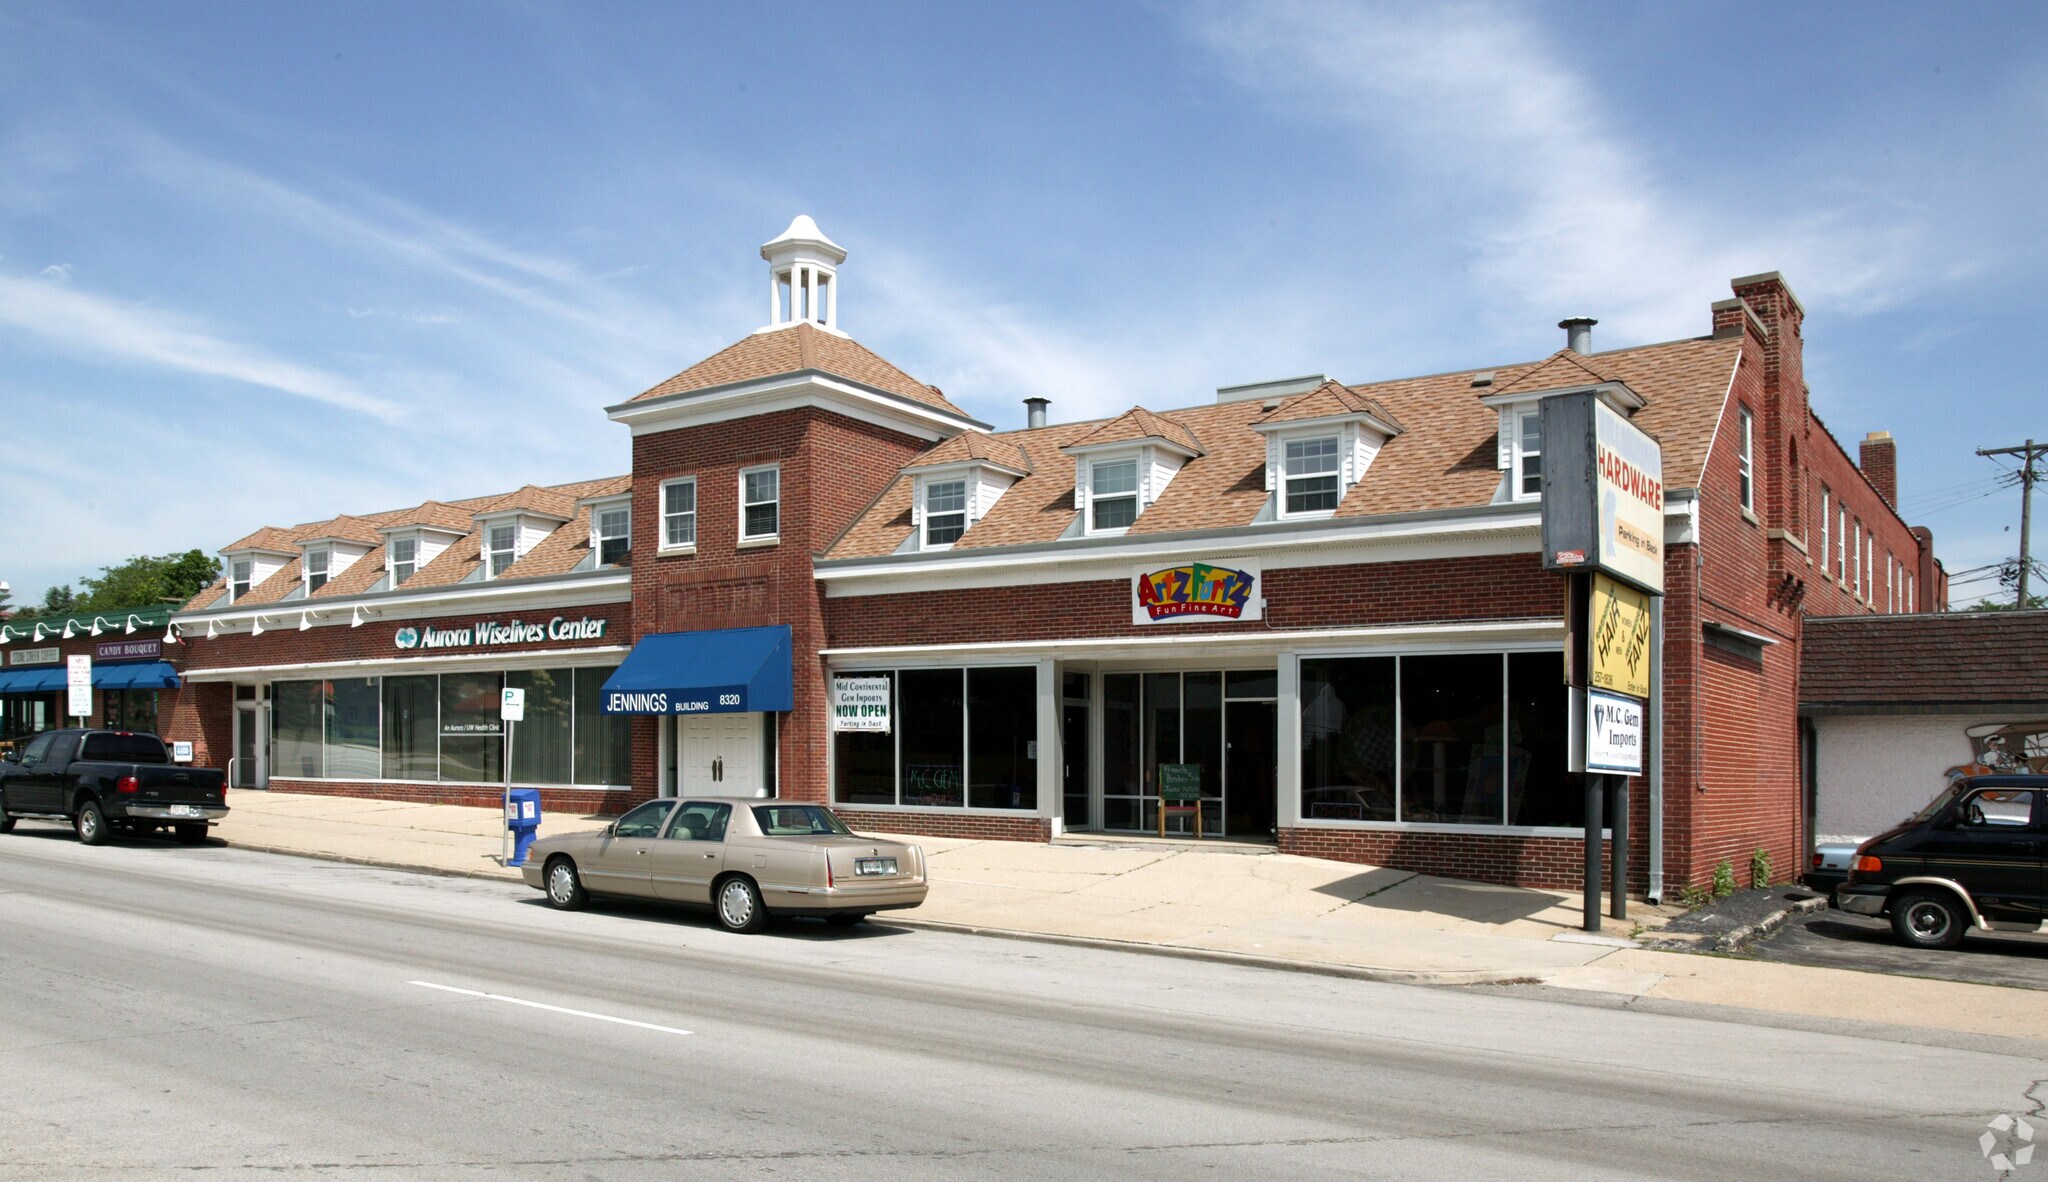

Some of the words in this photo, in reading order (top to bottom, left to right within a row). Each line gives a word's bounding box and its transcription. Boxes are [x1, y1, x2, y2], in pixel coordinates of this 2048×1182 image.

[1598, 443, 1661, 511] HARDWARE
[1618, 525, 1640, 548] Parking
[1640, 537, 1646, 549] in
[1646, 540, 1658, 555] Back
[1156, 604, 1177, 616] Fun
[1180, 603, 1207, 612] Fine
[1211, 604, 1233, 615] Art
[420, 626, 472, 648] Aurora
[475, 619, 545, 645] Wiselives
[548, 616, 606, 641] Center
[1598, 596, 1621, 668] HAIR
[99, 646, 122, 656] CANDY
[124, 643, 158, 655] BOUQUET
[1626, 607, 1649, 679] TANZ
[836, 680, 848, 691] Mid
[505, 691, 514, 701] P
[606, 693, 668, 712] JENNINGS
[675, 701, 709, 712] BUILDING
[720, 694, 740, 706] 8320
[836, 704, 858, 718] NOW
[861, 704, 887, 718] OPEN
[1624, 708, 1639, 728] Gem
[489, 723, 500, 731] Clinic
[1609, 729, 1637, 748] Imports
